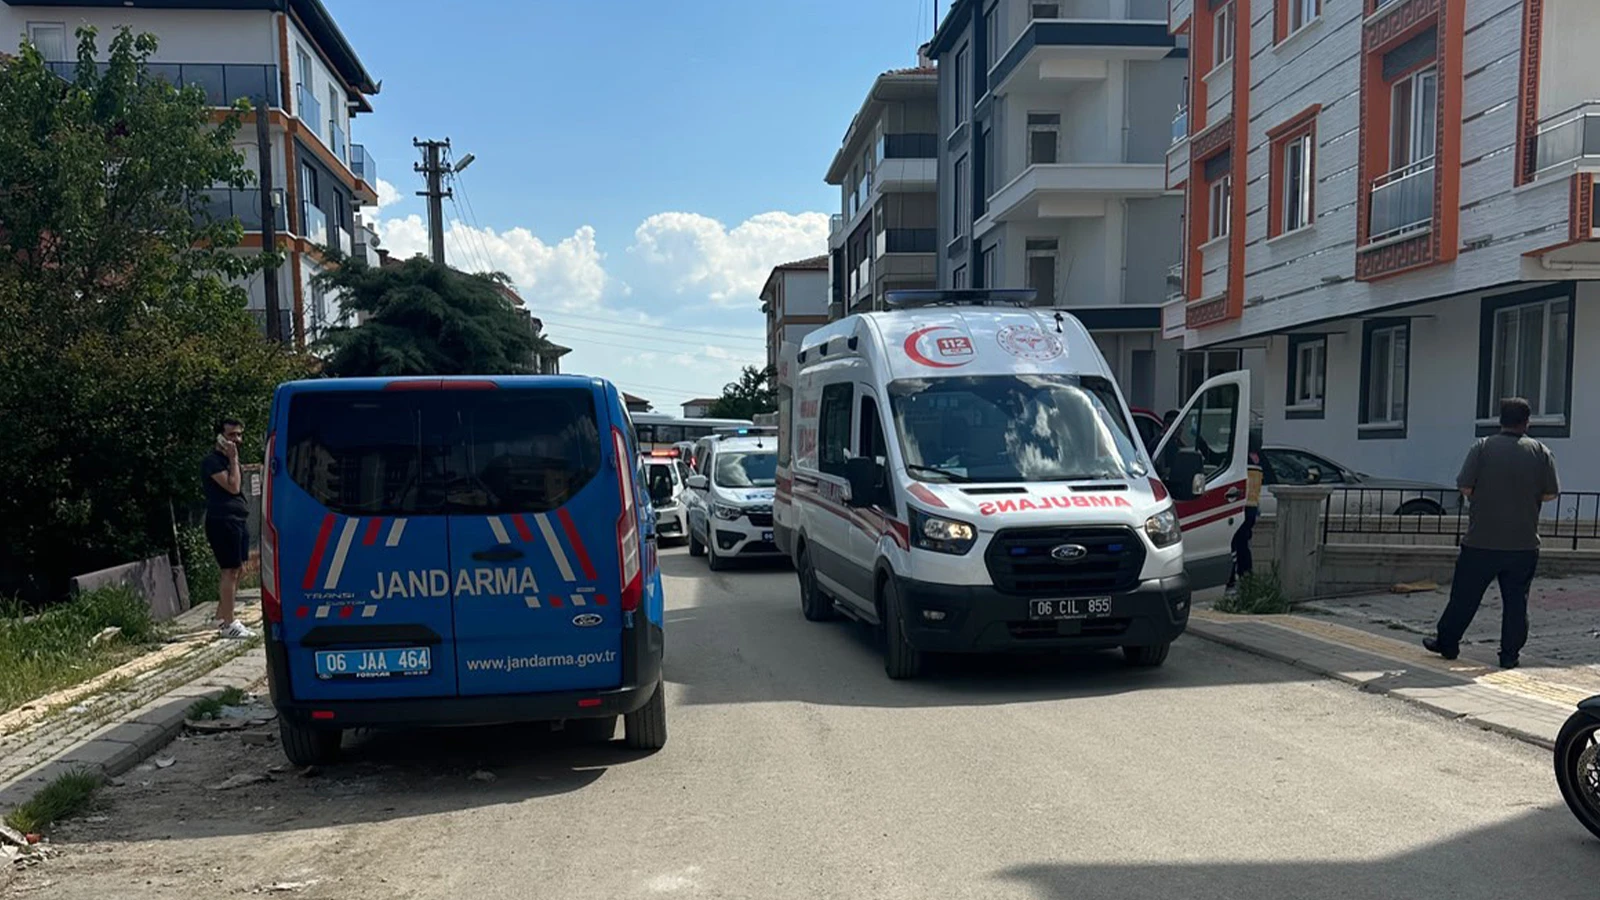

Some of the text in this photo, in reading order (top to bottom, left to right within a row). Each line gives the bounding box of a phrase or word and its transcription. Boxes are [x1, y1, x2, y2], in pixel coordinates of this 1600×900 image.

[942, 338, 967, 349] 112
[370, 566, 540, 600] JANDARMA
[1037, 598, 1110, 616] 06 CIL 855
[326, 649, 428, 672] 06 JAA 464
[466, 649, 617, 672] www.jandarma.gov.tr
